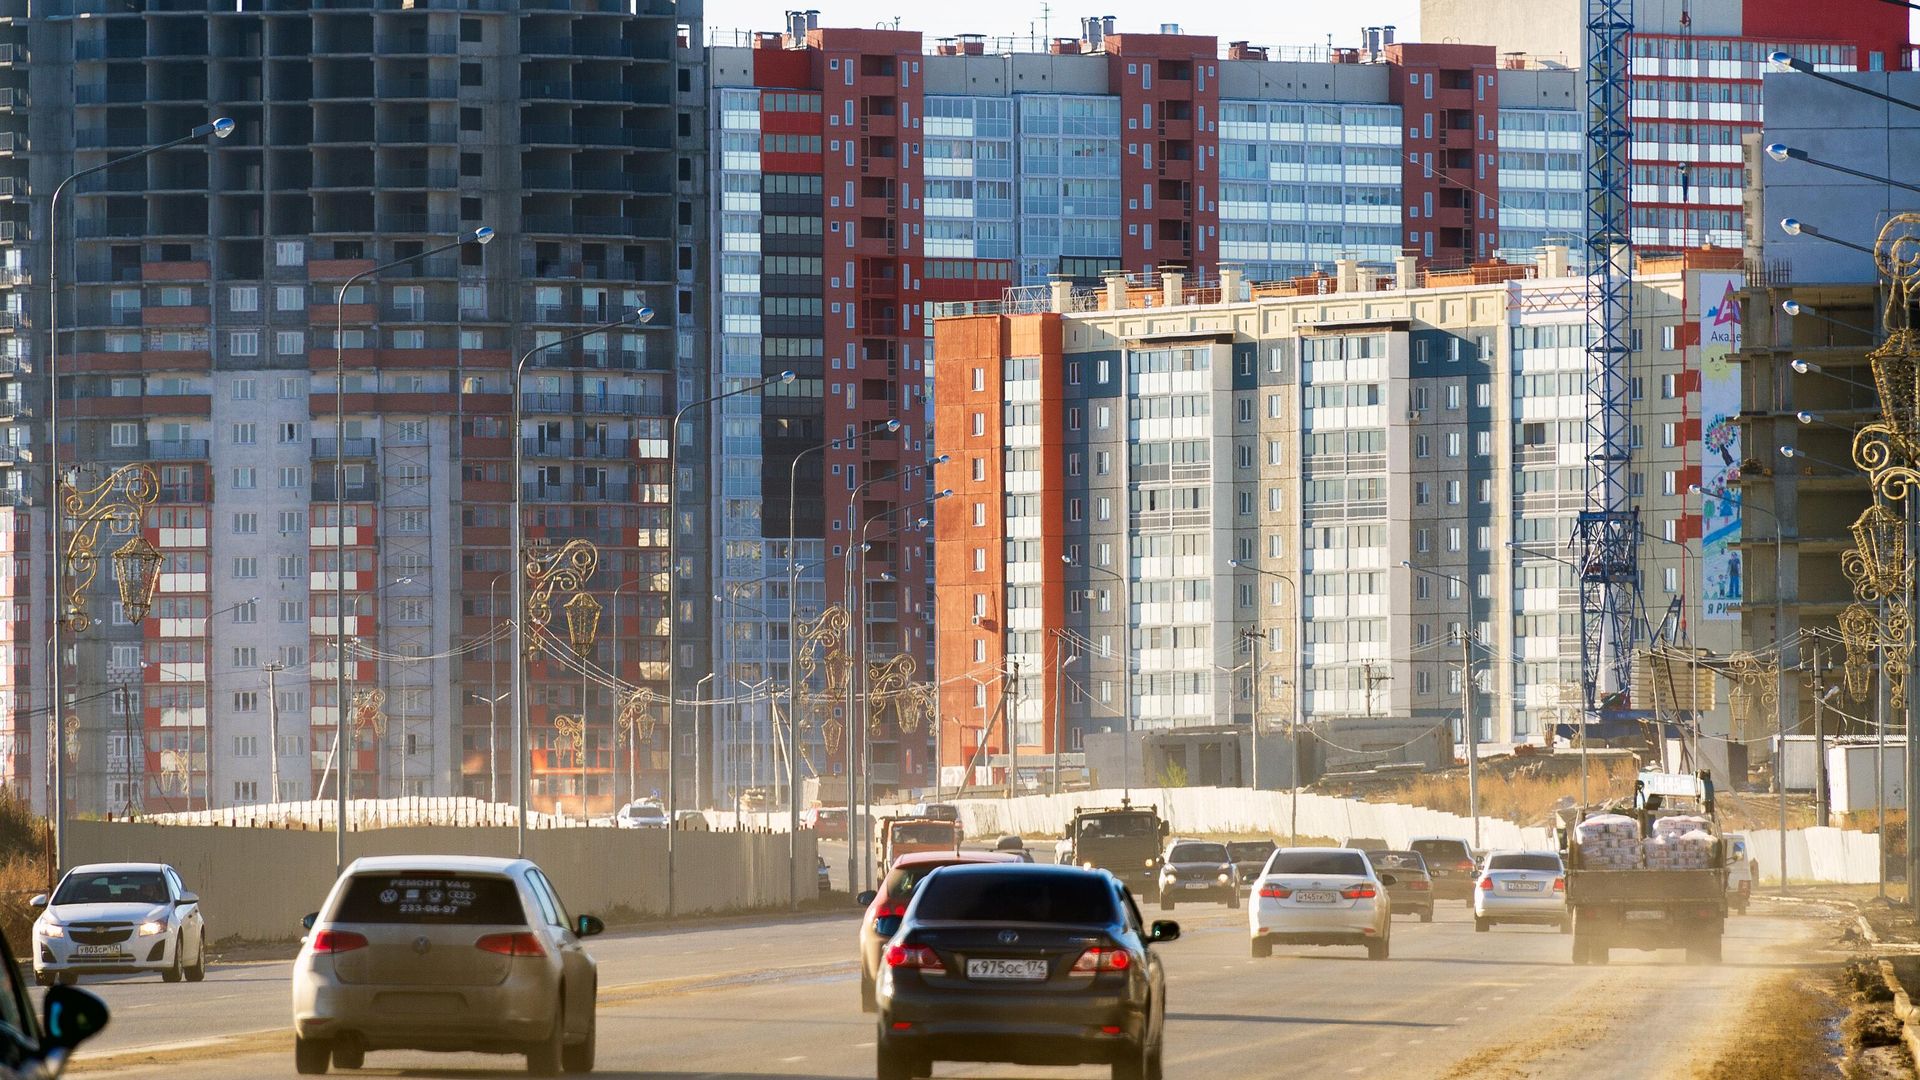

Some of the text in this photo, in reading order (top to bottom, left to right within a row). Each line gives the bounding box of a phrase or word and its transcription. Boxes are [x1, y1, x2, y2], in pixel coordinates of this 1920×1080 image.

[1707, 603, 1714, 614] Я
[390, 879, 442, 887] РЕМОНТ
[1025, 960, 1045, 971] 174
